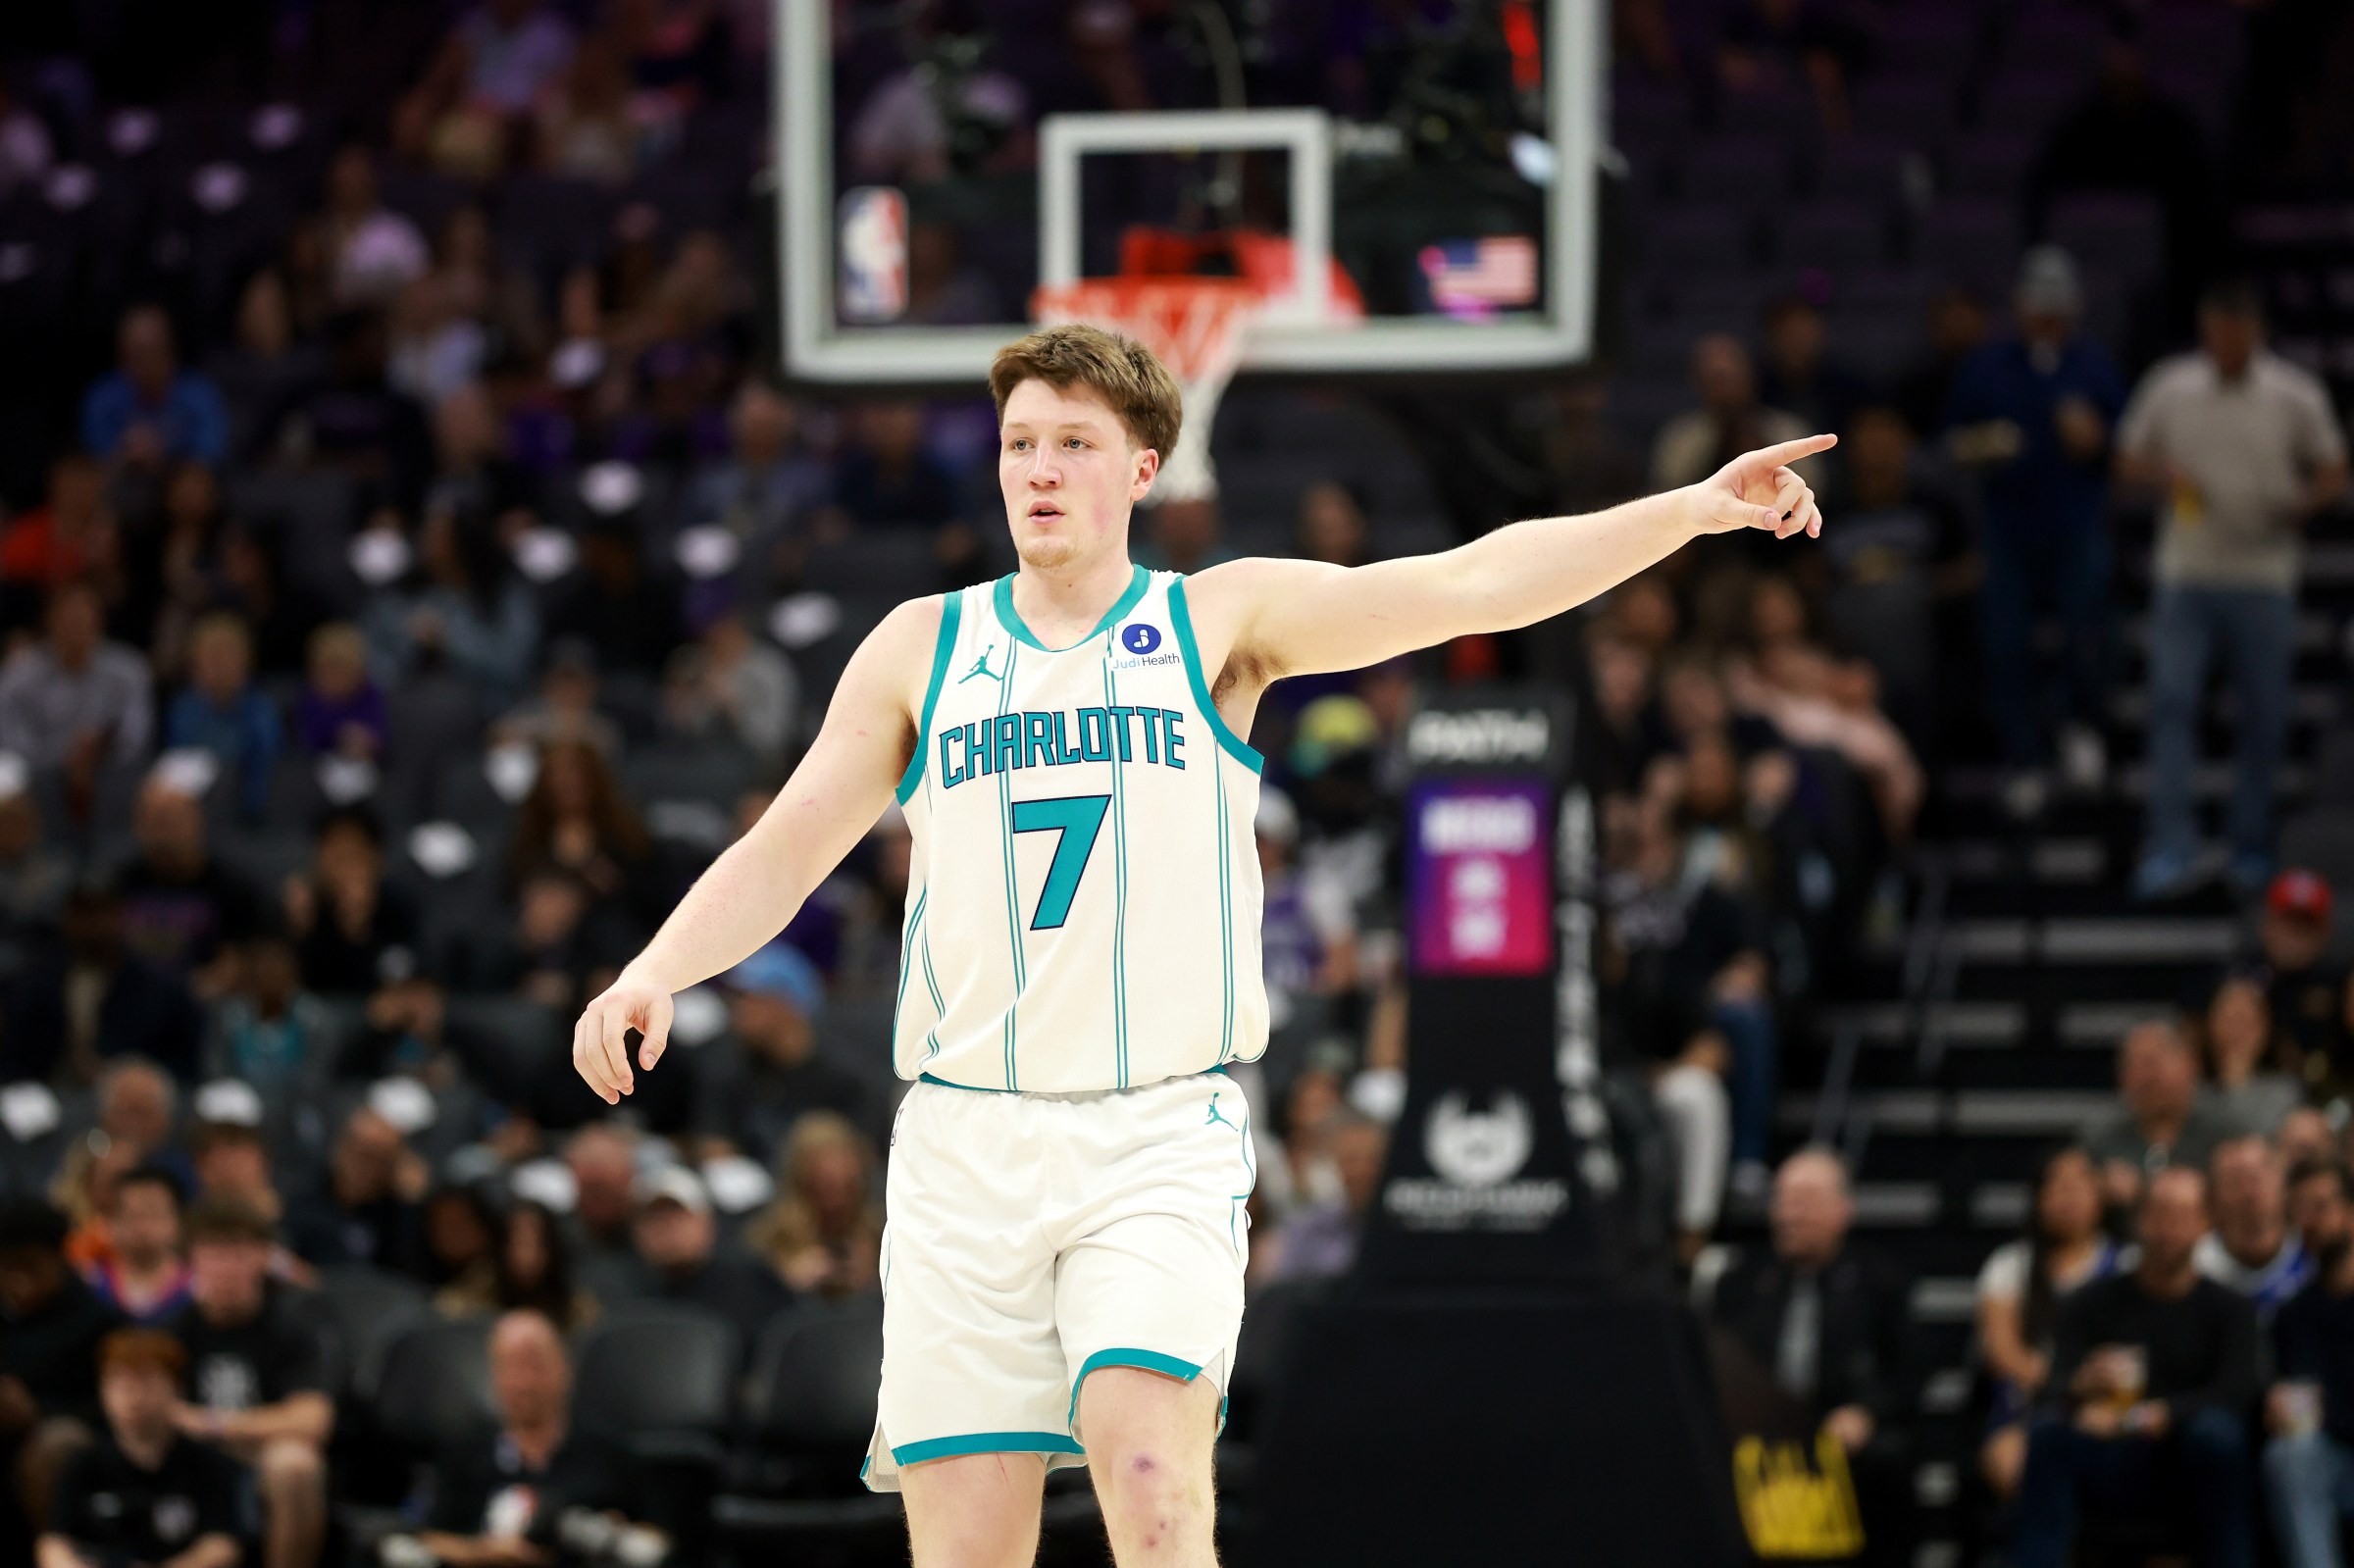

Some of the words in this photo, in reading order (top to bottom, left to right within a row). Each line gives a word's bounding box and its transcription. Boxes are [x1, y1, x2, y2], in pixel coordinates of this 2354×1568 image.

[1112, 658, 1140, 669] Judi
[1142, 653, 1180, 667] Health
[940, 706, 1186, 789] CHARLOTTE
[1011, 794, 1112, 931] 7
